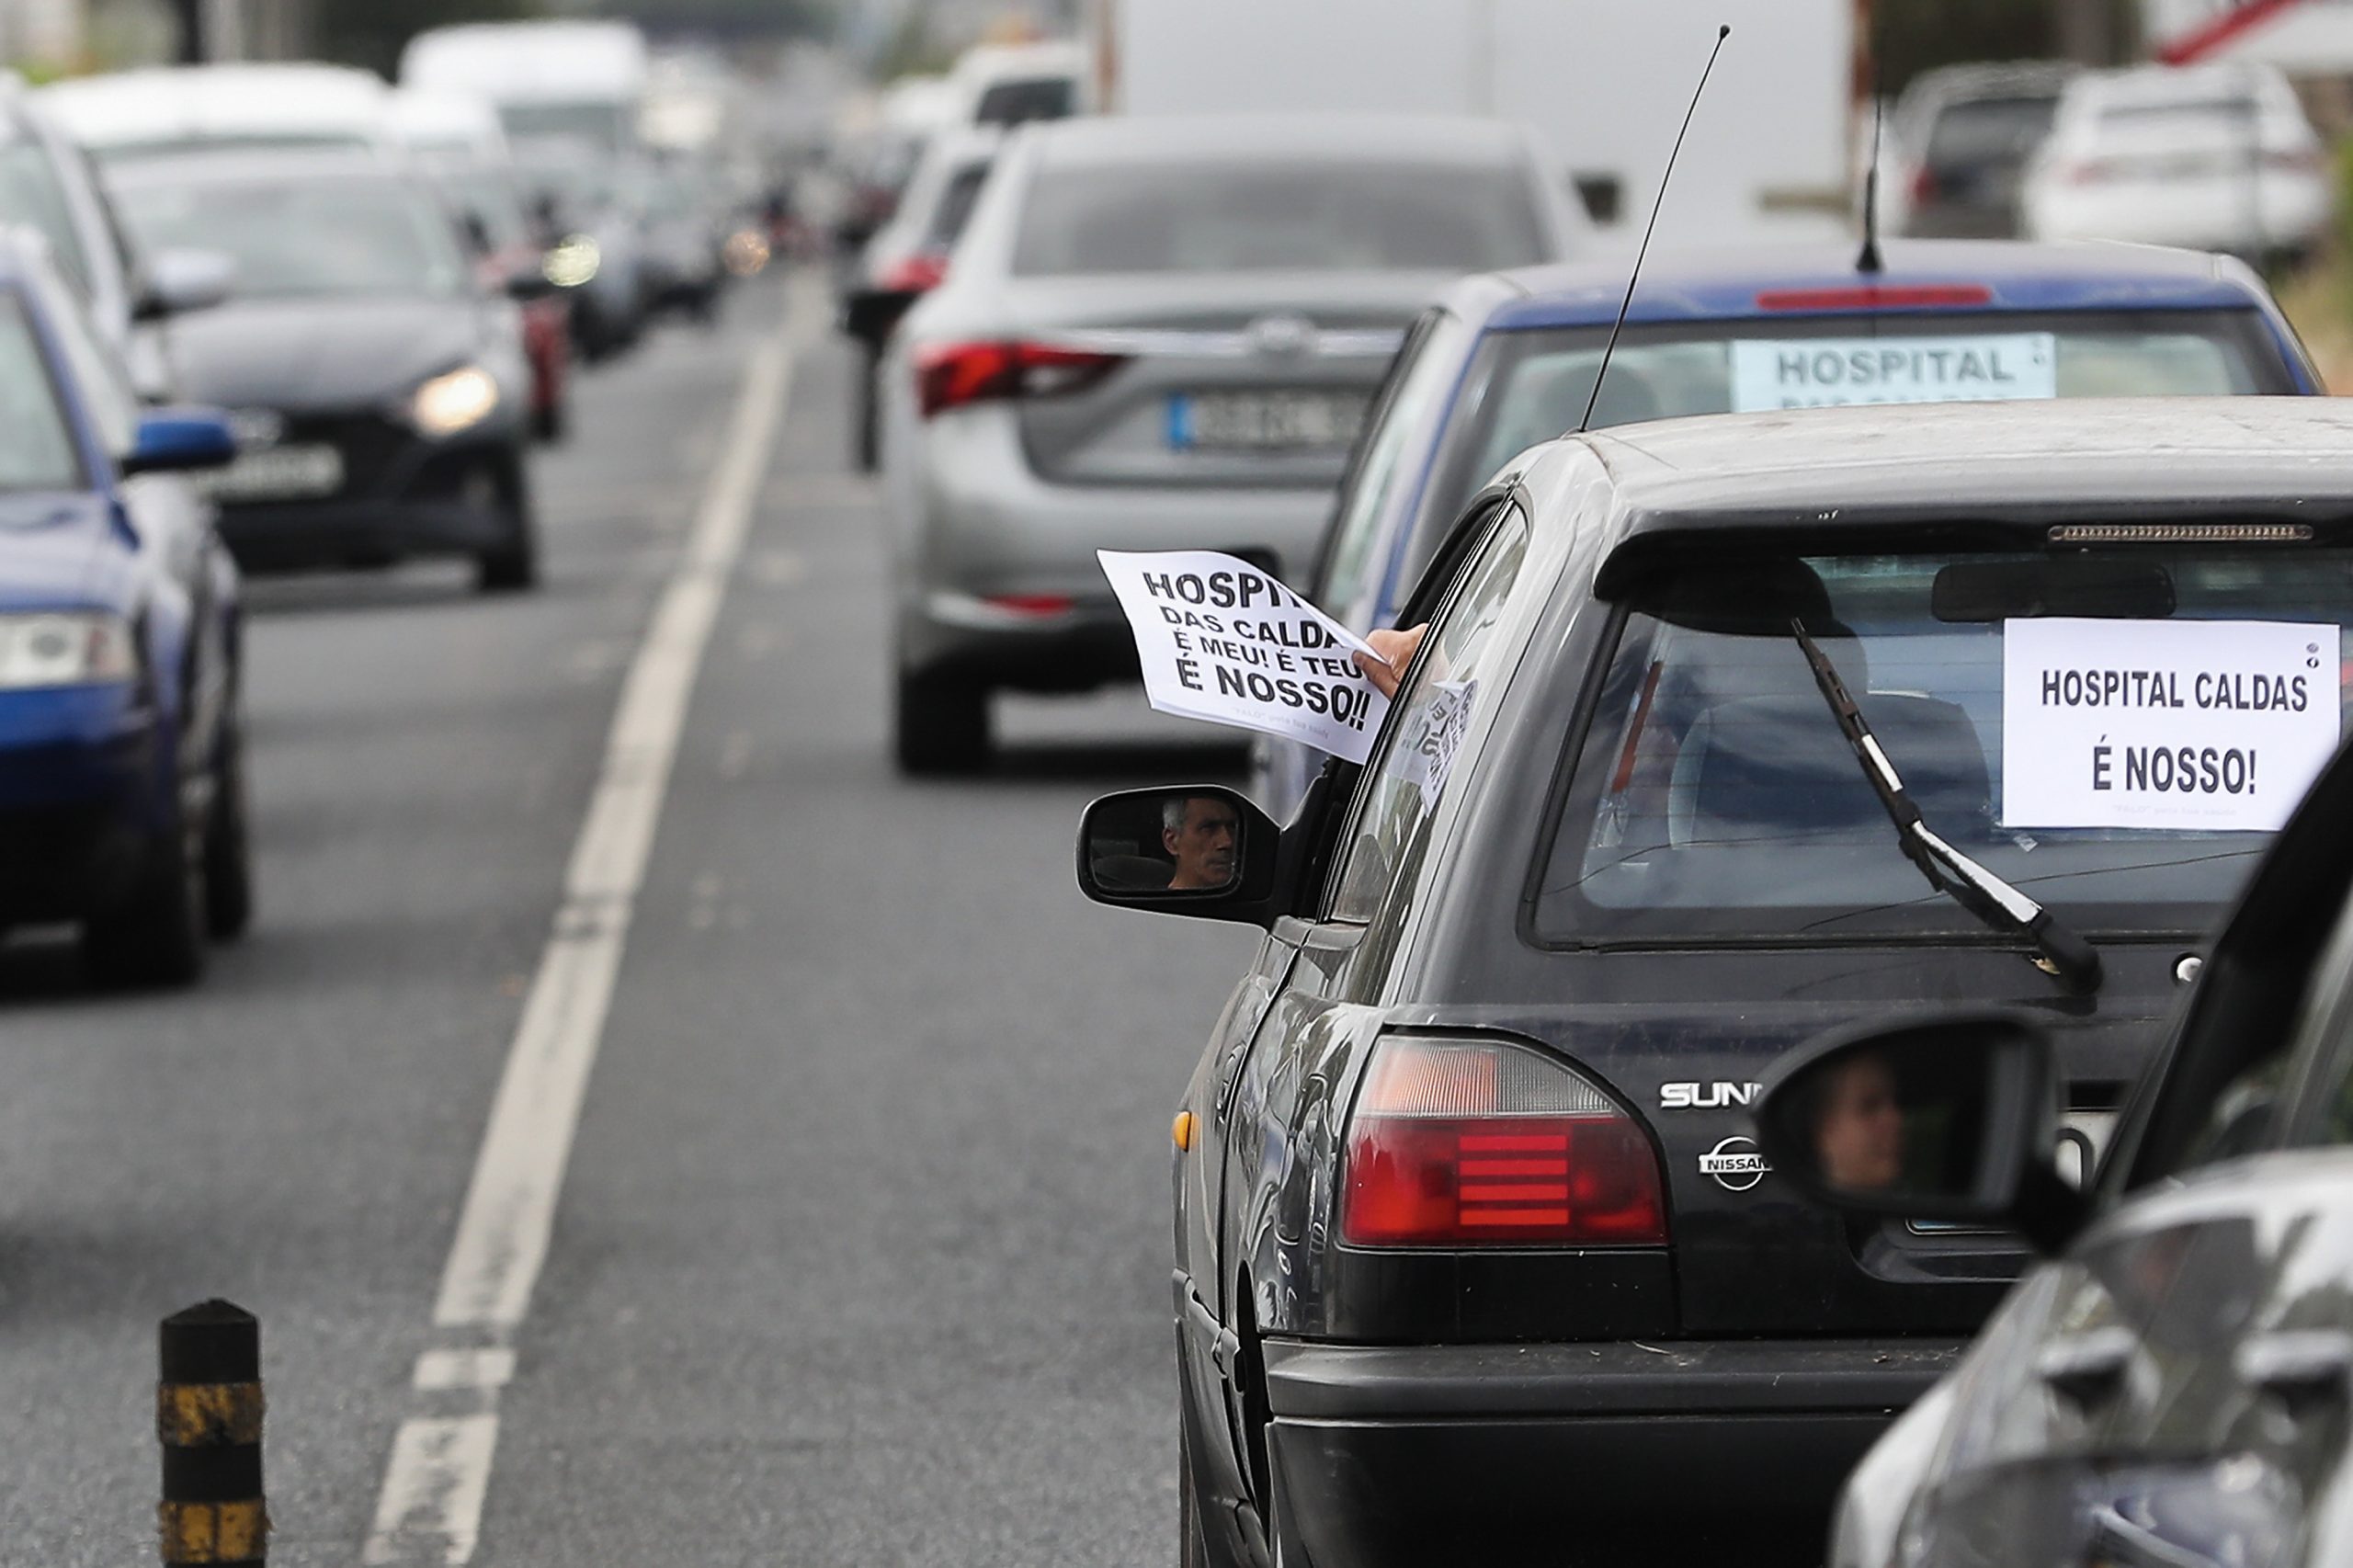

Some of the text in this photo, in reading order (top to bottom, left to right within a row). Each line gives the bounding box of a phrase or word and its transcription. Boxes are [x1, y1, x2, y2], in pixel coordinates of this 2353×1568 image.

[1778, 348, 2017, 385] HOSPITAL
[1159, 606, 1224, 632] DAS
[1174, 627, 1192, 651] É
[1199, 636, 1269, 668] MEU!
[1276, 649, 1296, 673] É
[1176, 653, 1203, 690] É
[1215, 665, 1371, 732] NOSSO!!
[2041, 669, 2308, 711] HOSPITAL CALDAS
[2093, 734, 2256, 794] É NOSSO!
